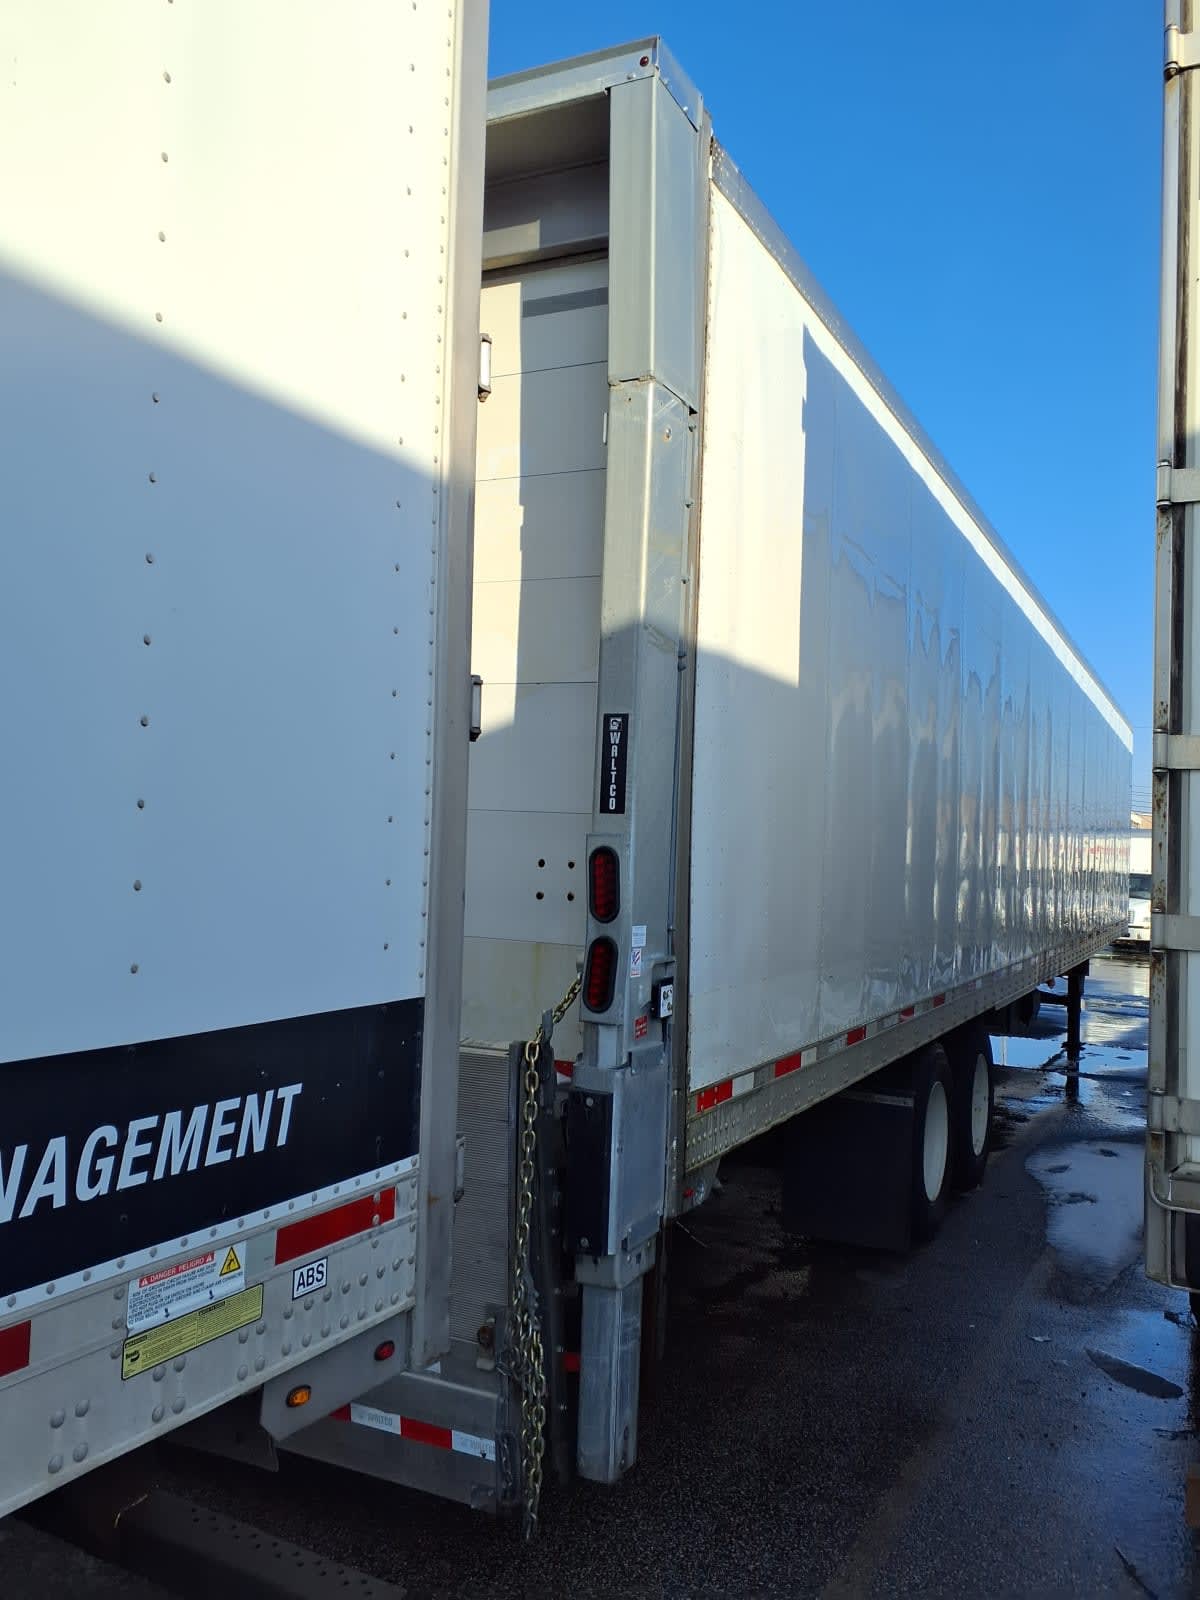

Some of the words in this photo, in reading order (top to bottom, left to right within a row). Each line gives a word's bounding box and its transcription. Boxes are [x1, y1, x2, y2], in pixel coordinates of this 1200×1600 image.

[608, 731, 621, 810] WALTCO
[150, 1267, 177, 1283] DANGER
[178, 1257, 205, 1272] PELIGRO
[296, 1263, 325, 1291] ABS
